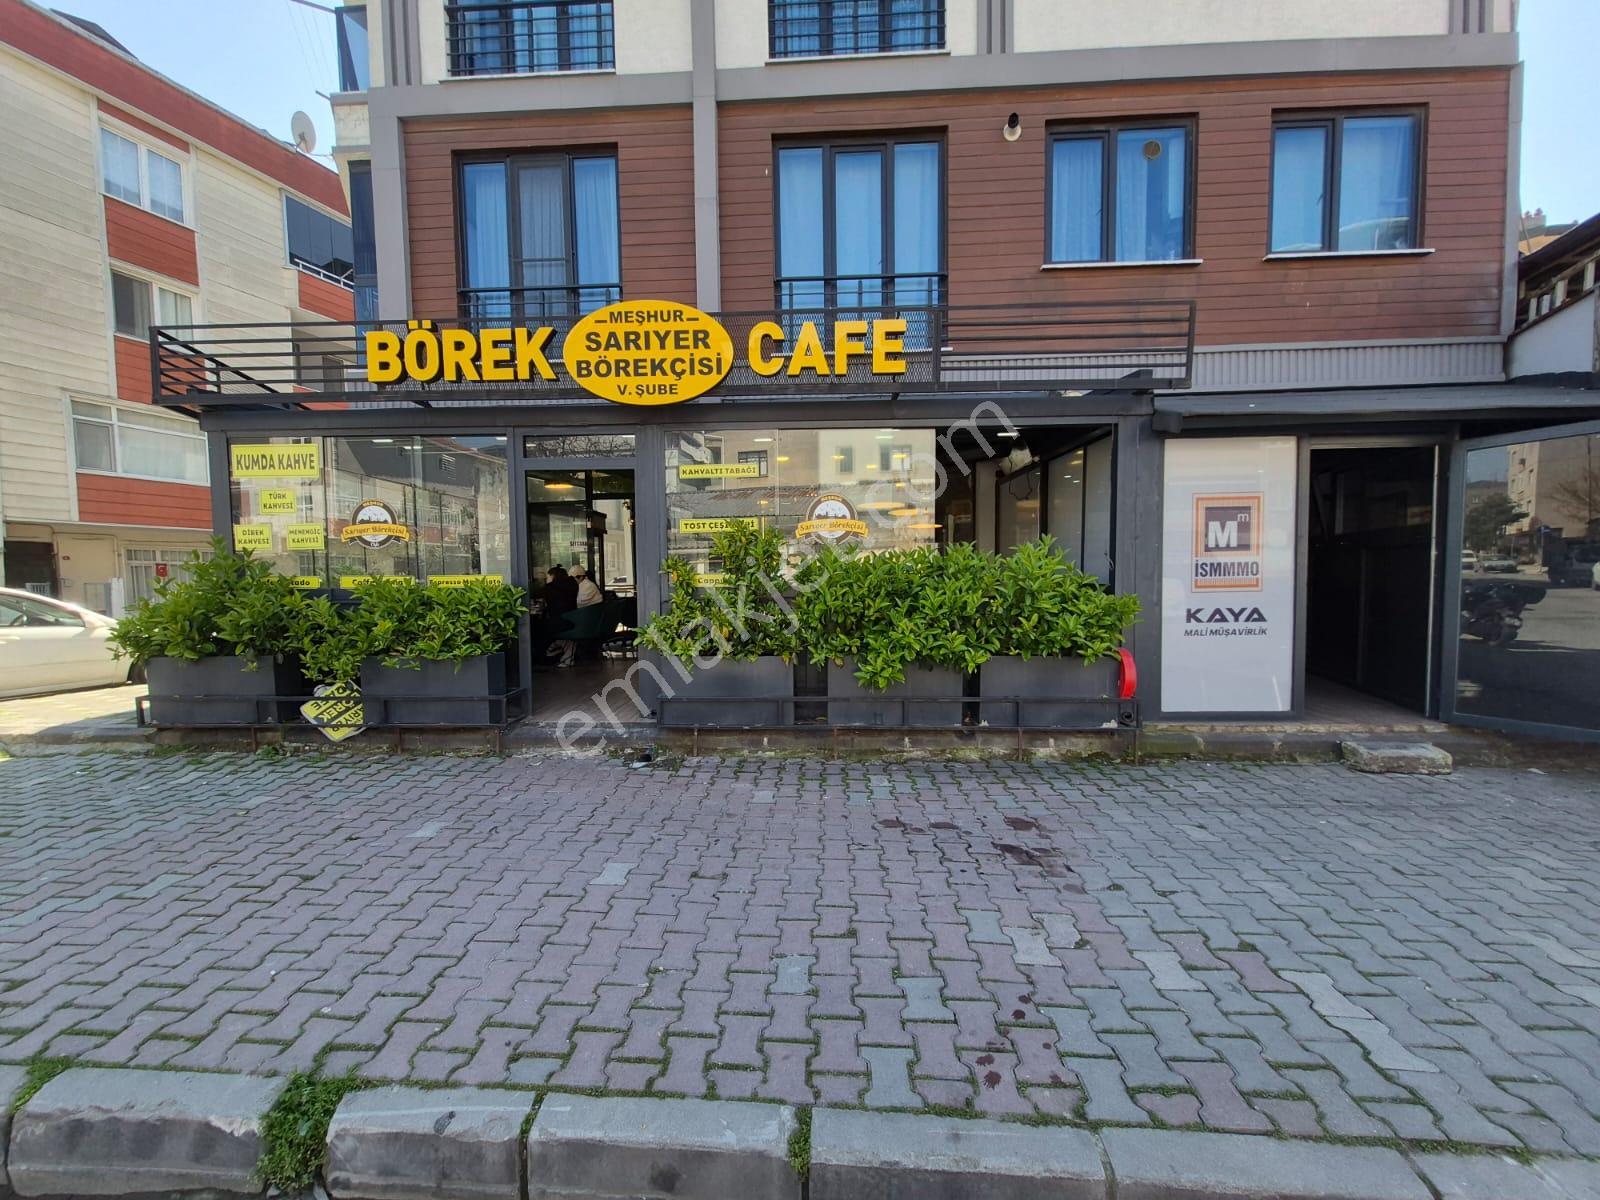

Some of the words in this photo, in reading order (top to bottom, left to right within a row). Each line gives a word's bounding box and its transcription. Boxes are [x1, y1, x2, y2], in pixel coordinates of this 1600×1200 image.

[609, 310, 684, 326] MEŞHUR
[585, 330, 711, 352] SARIYER
[748, 319, 907, 376] CAFE
[365, 320, 557, 382] BÖREK
[576, 353, 722, 380] BÖREKÇİSİ
[617, 385, 632, 396] V.
[635, 384, 679, 398] ŞUBE
[236, 454, 276, 471] KUMDA
[278, 453, 315, 470] KAHVE
[268, 491, 287, 500] TÜRK
[683, 522, 706, 530] TOST
[1194, 559, 1260, 578] İSMMMO
[1185, 607, 1268, 624] KAYA
[1183, 627, 1208, 637] MALİ
[1209, 626, 1268, 637] MÜŞAVİRLİK
